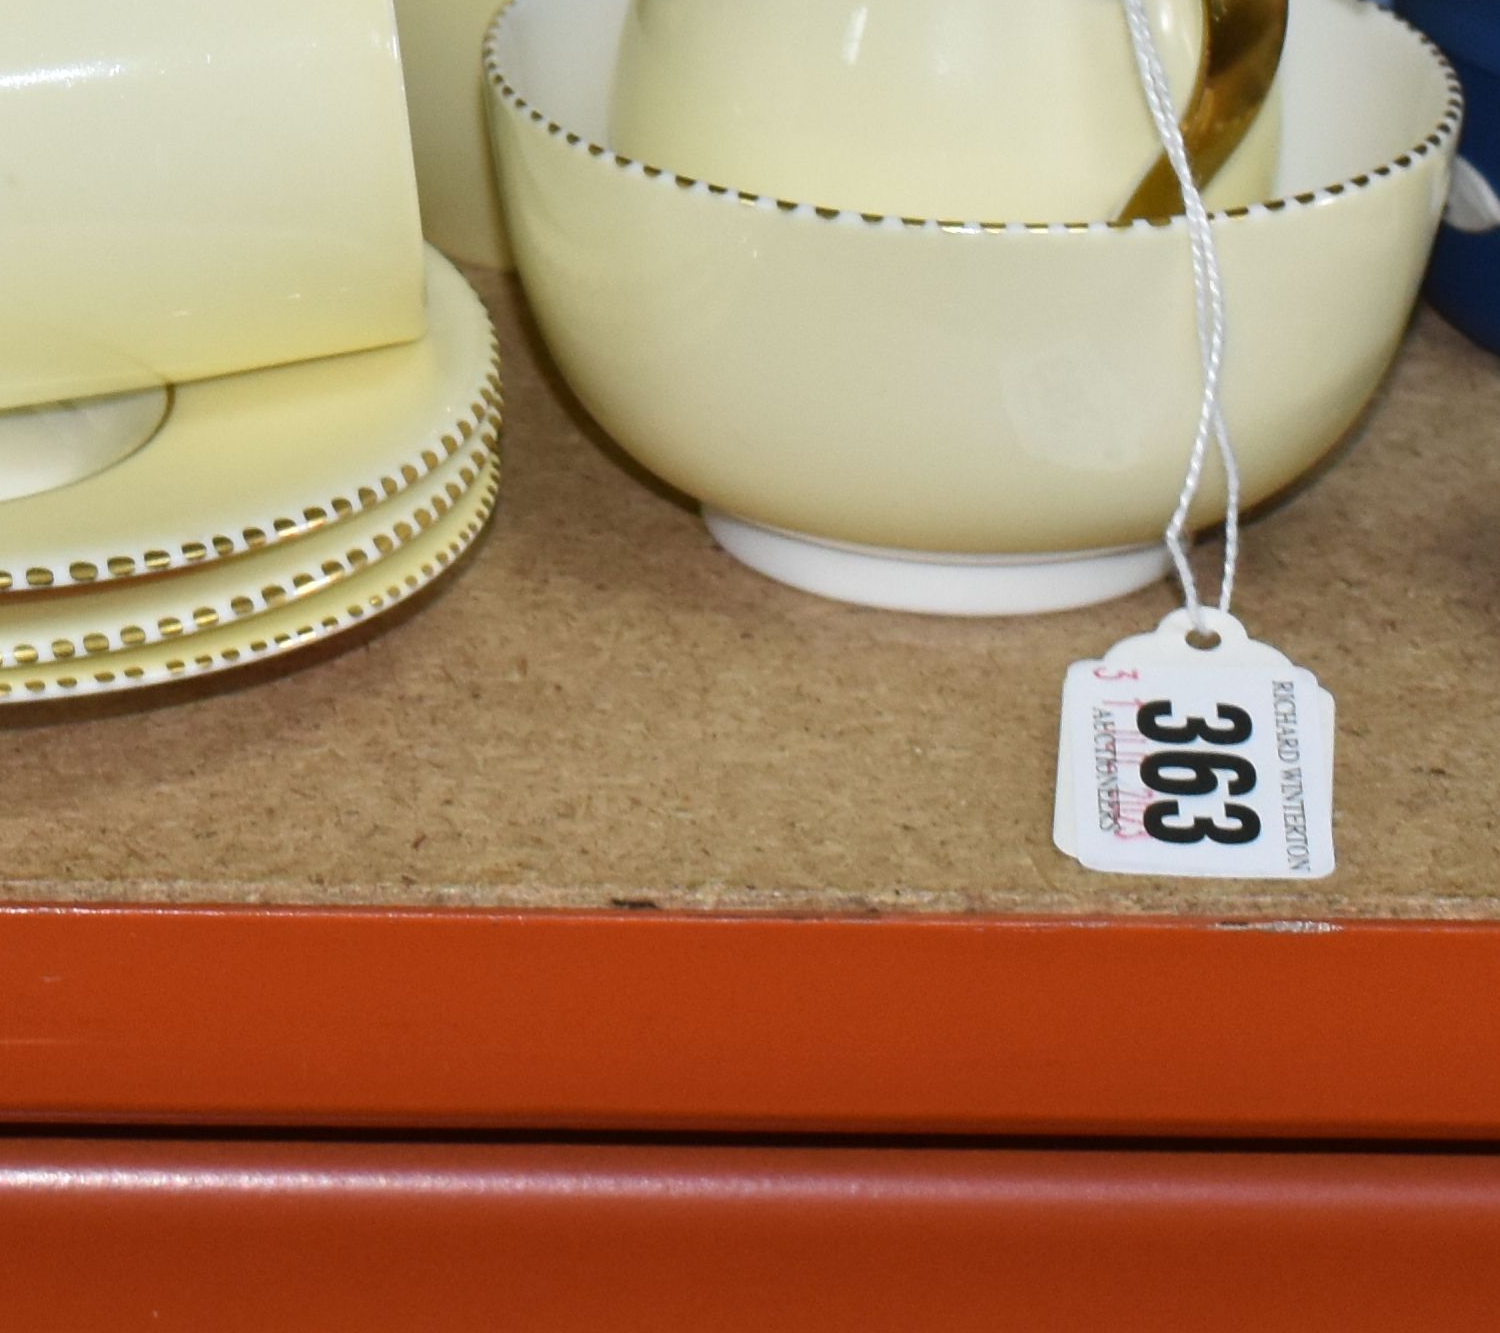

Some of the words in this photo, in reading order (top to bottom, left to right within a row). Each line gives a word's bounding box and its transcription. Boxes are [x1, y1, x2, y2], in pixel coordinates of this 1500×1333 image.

[1092, 705, 1122, 832] AUCTIONEERS
[1136, 699, 1261, 845] 363
[1271, 680, 1301, 764] RICHARD
[1279, 766, 1312, 872] WINTERTON
